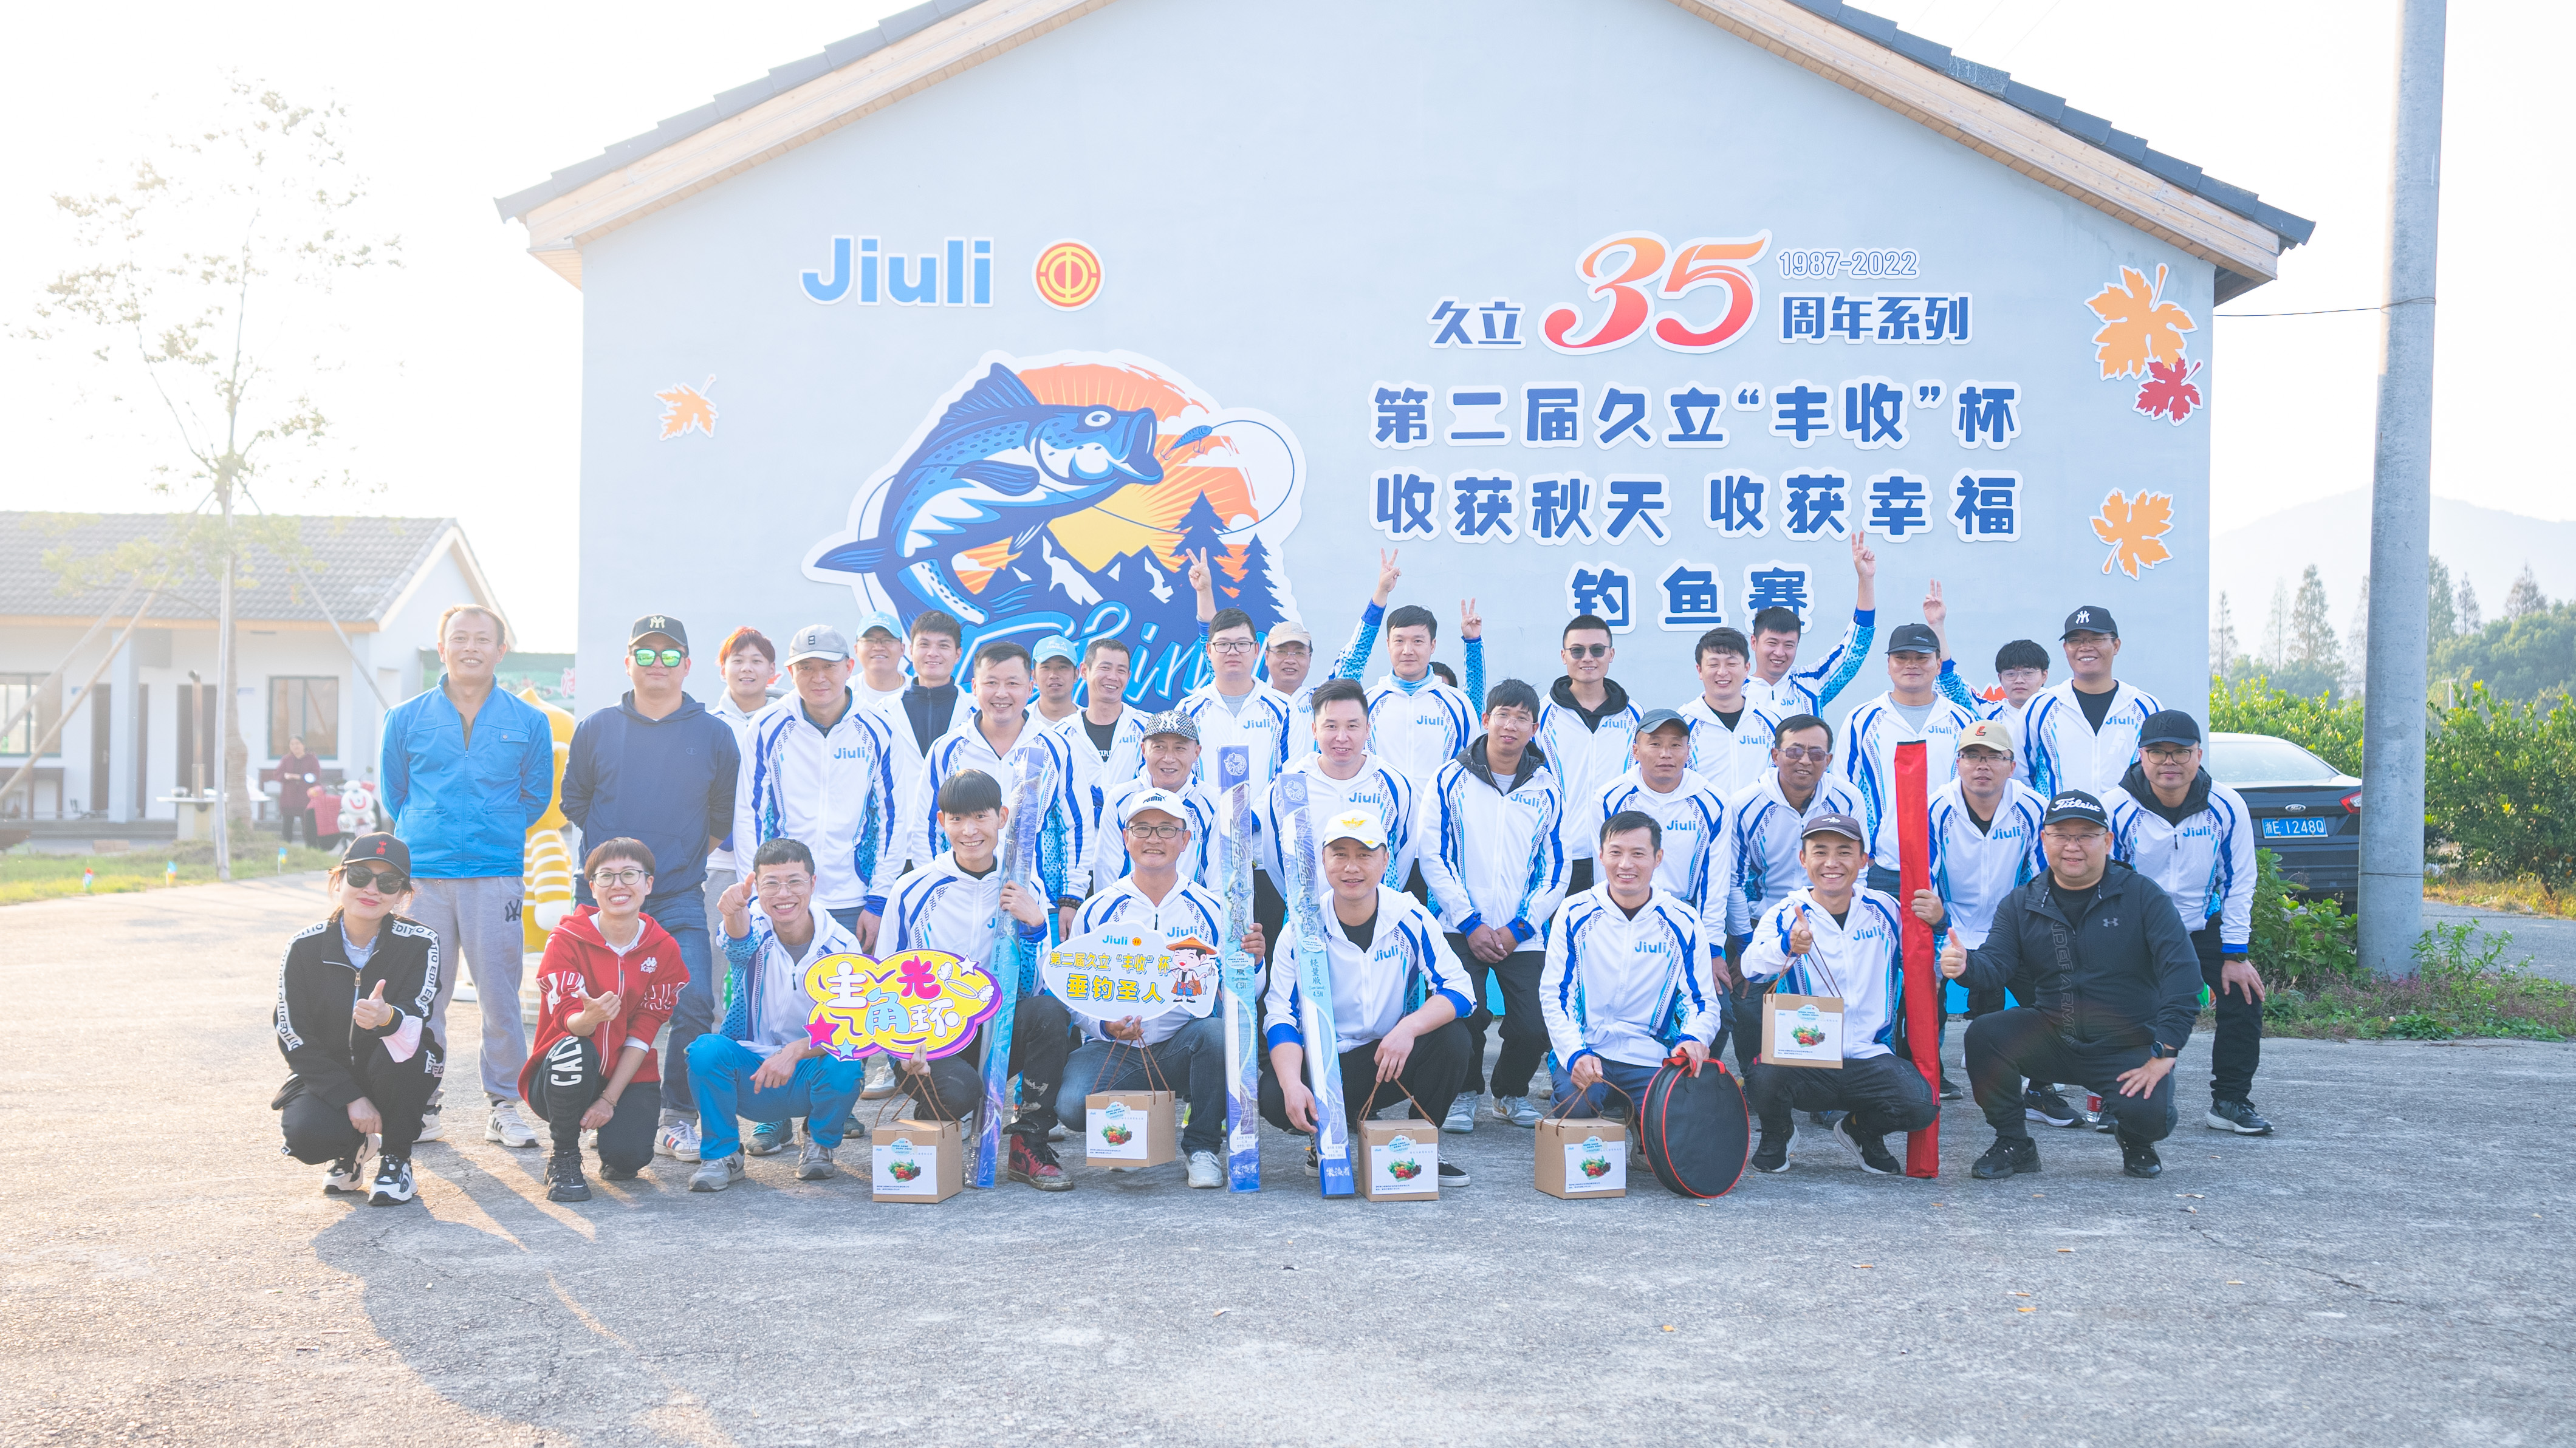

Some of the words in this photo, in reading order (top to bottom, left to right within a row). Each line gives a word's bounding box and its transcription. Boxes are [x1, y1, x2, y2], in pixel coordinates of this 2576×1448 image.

[1780, 251, 1917, 276] 1987-2022
[802, 237, 991, 305] Jiuli
[1433, 301, 1522, 345] 久立
[1544, 236, 1768, 347] 35
[1783, 295, 1968, 340] 周年系列
[1377, 474, 1665, 537] 收获秋天
[1710, 474, 2016, 536] 收获幸福
[1297, 705, 1313, 714] iuli
[1243, 719, 1271, 729] Jiuli
[1416, 715, 1444, 726] Jiuli
[1600, 719, 1628, 729] Jiuli
[2105, 716, 2134, 726] Jiuli
[1928, 725, 1952, 735] Jiuli
[1739, 735, 1766, 745] Jiuli
[834, 746, 865, 760] Jiuli
[1143, 795, 1162, 804] PUMA
[1349, 791, 1381, 805] Jiuli
[1509, 792, 1541, 808] Jiuli
[2051, 797, 2102, 813] Titleist
[1667, 819, 1697, 831] Jiuli
[1992, 826, 2022, 840] Jiuli
[2183, 826, 2212, 838] Jiuli
[1166, 926, 1198, 939] Jiuli
[1853, 926, 1882, 941] Jiuli
[1102, 935, 1128, 946] Jiuli
[1374, 944, 1399, 963] Jiuli
[1635, 941, 1667, 954] Jiuli
[1066, 973, 1165, 1004] 垂钓圣人
